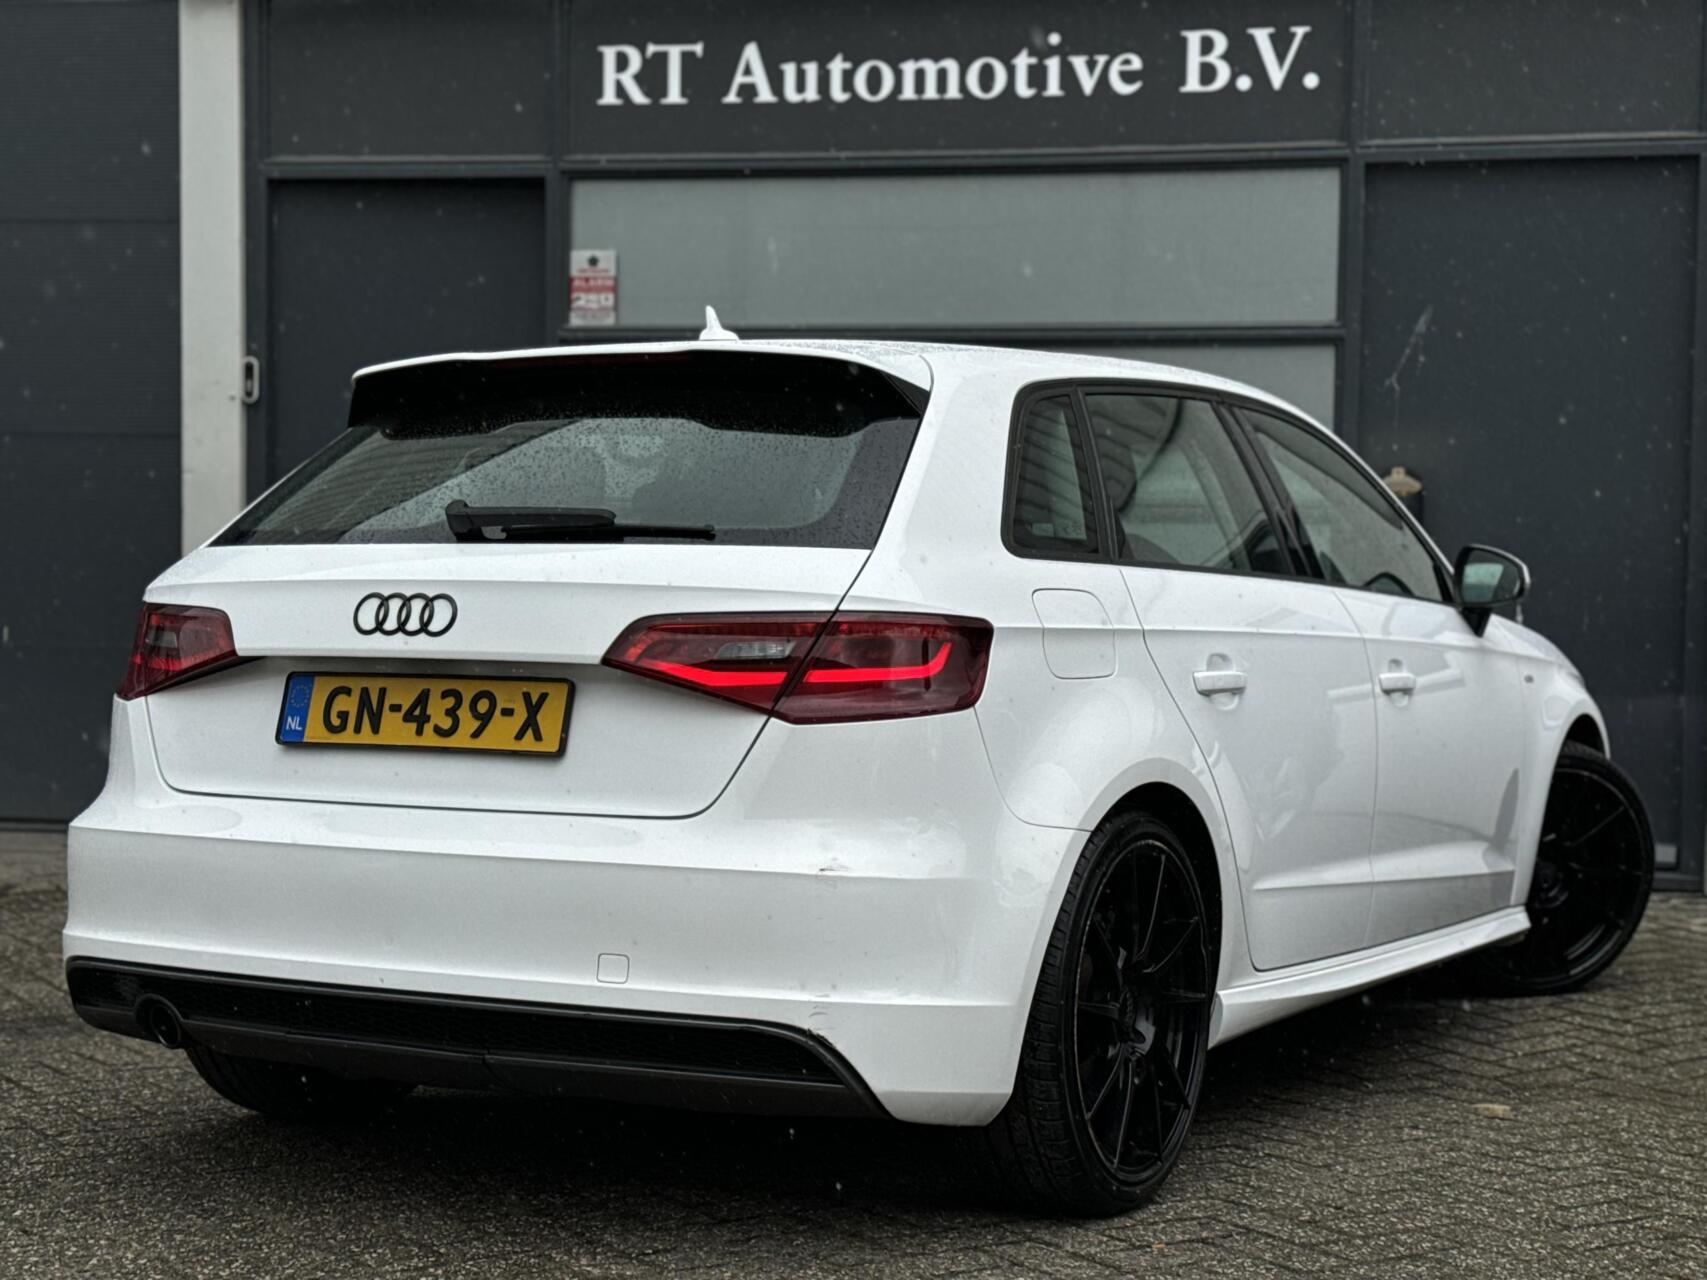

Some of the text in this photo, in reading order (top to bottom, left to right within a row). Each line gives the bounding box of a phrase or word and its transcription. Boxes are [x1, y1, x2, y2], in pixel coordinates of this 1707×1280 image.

[596, 25, 1320, 106] RT Automotive B.V.
[285, 685, 549, 742] NL GN-439-X
